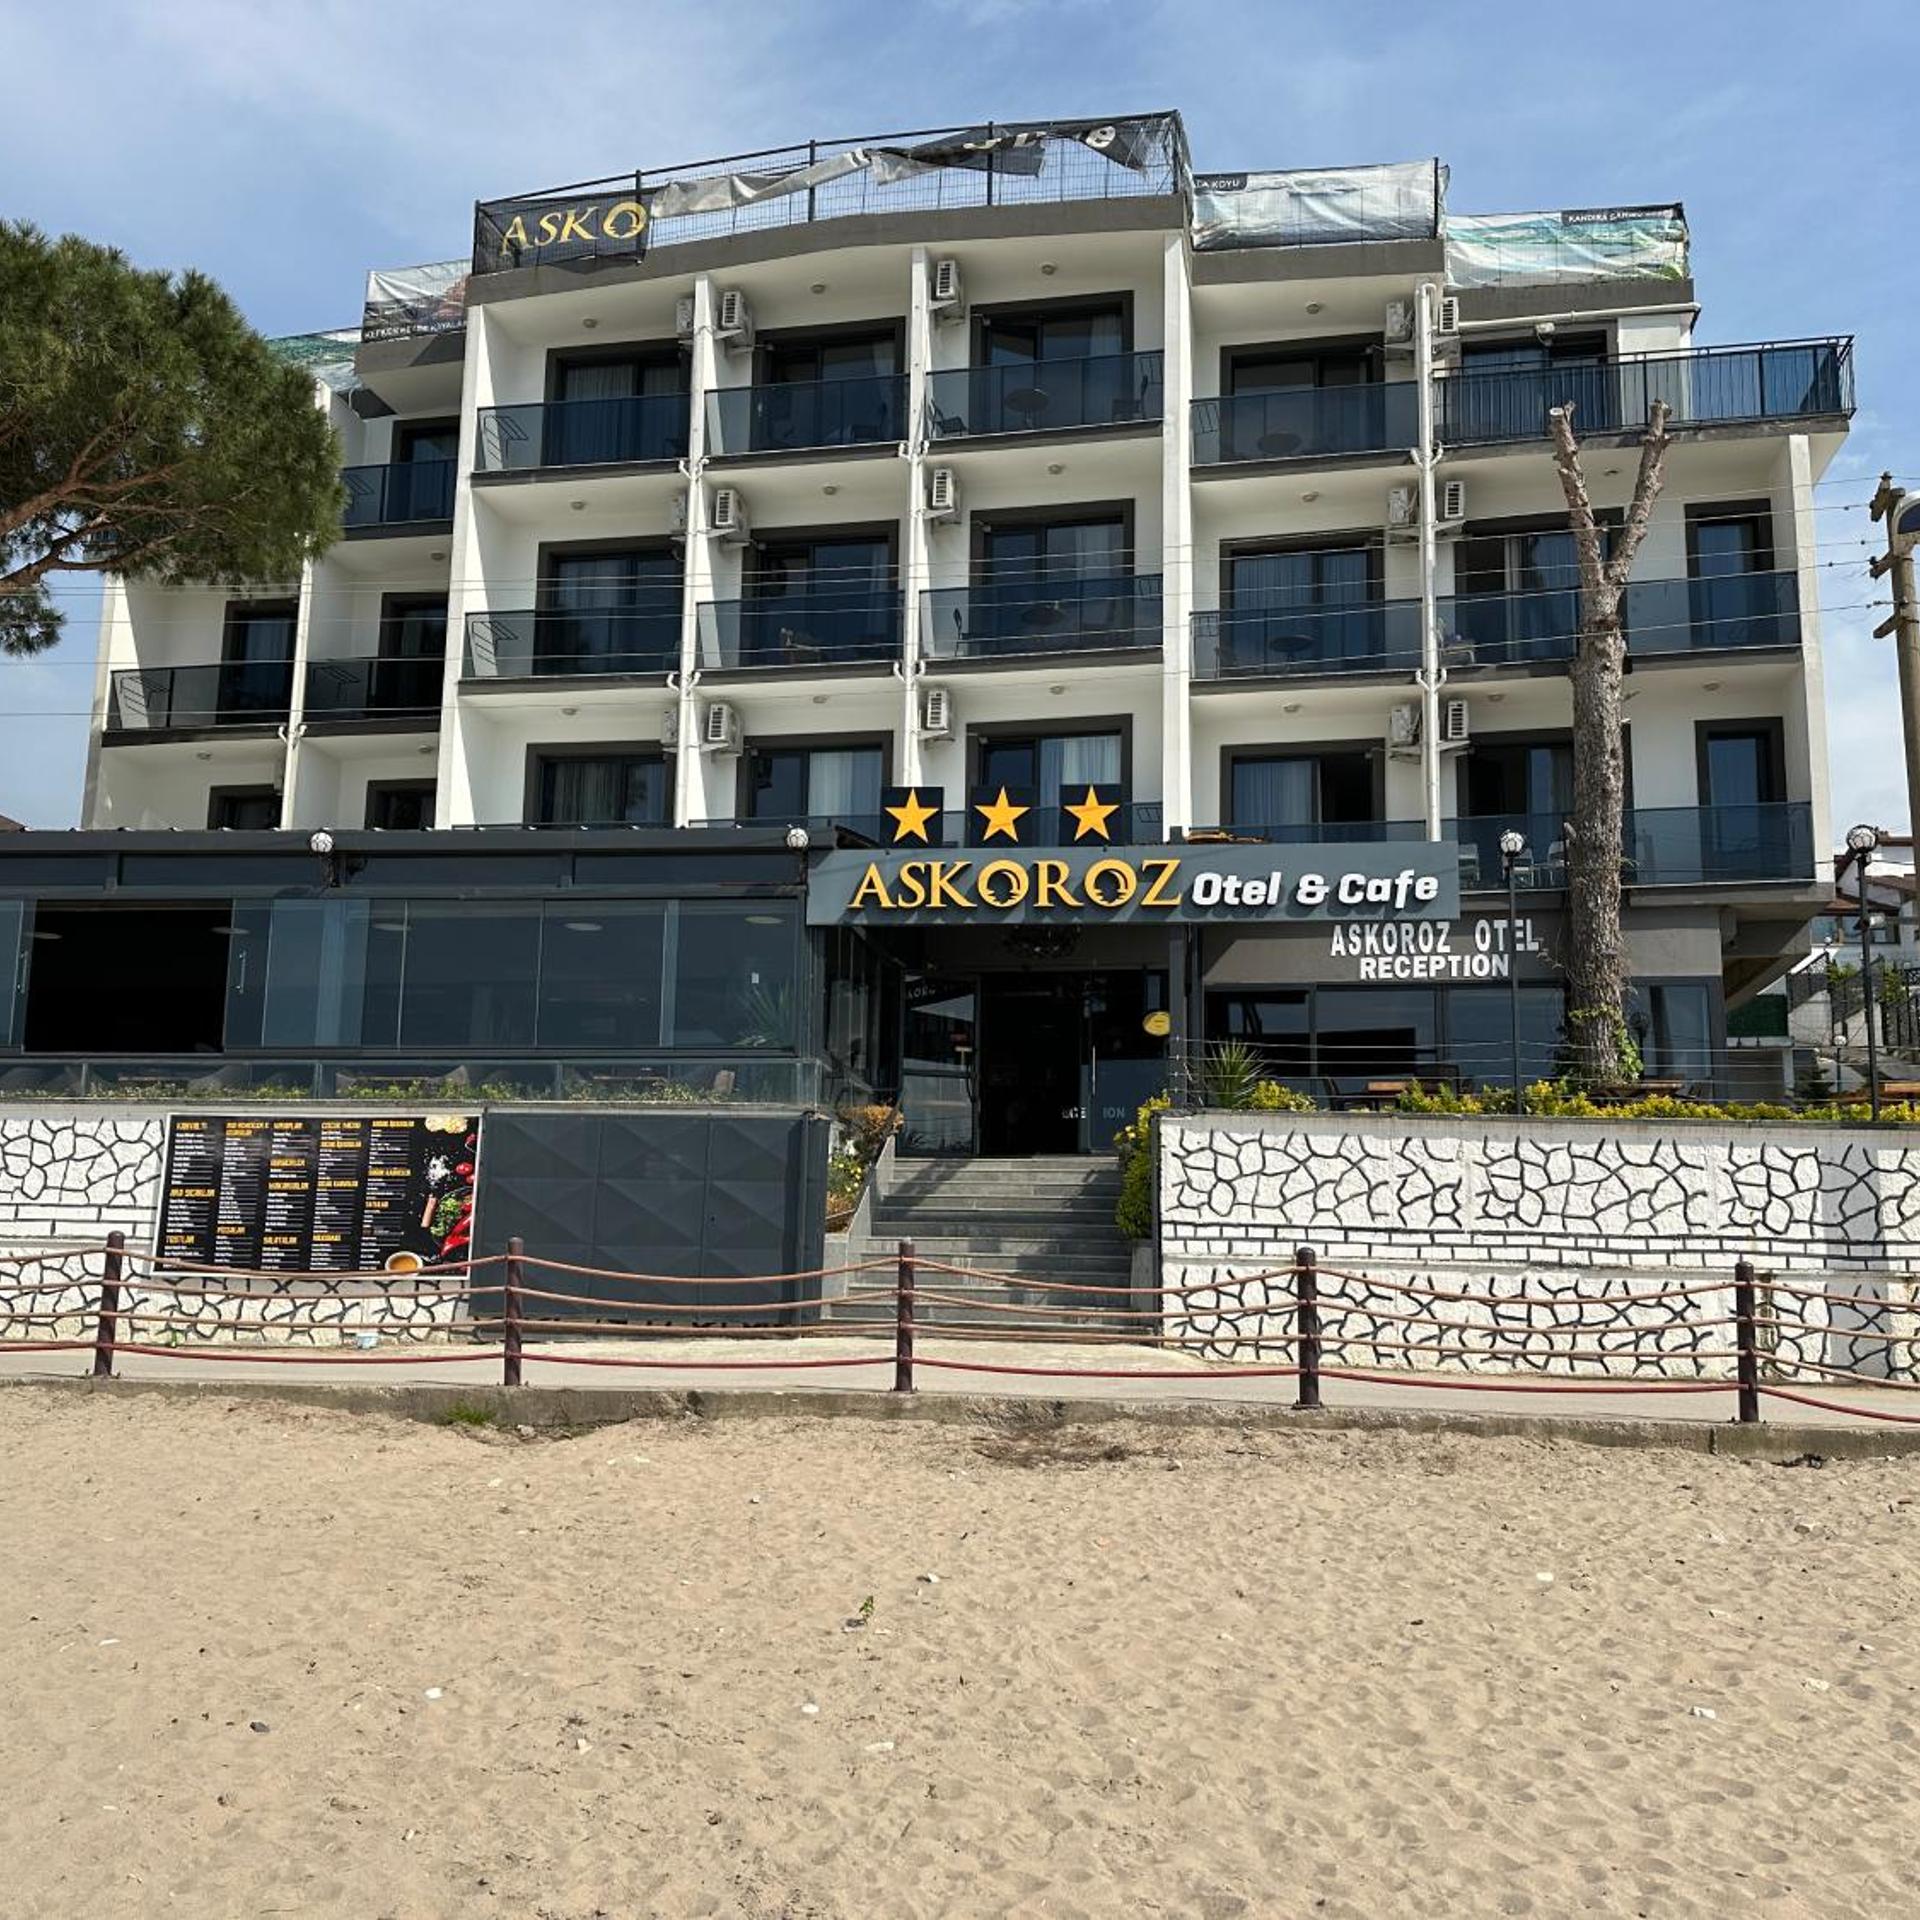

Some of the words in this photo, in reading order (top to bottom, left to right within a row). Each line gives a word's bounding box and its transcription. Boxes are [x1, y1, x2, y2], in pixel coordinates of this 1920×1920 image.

[849, 858, 1182, 908] ASKOROZ
[1192, 870, 1282, 906] Otel
[1296, 873, 1330, 904] &
[1338, 869, 1439, 908] Cafe
[1331, 921, 1450, 956] ASKOROZ
[1475, 919, 1539, 952] OTEL
[1360, 954, 1508, 980] RECEPTION
